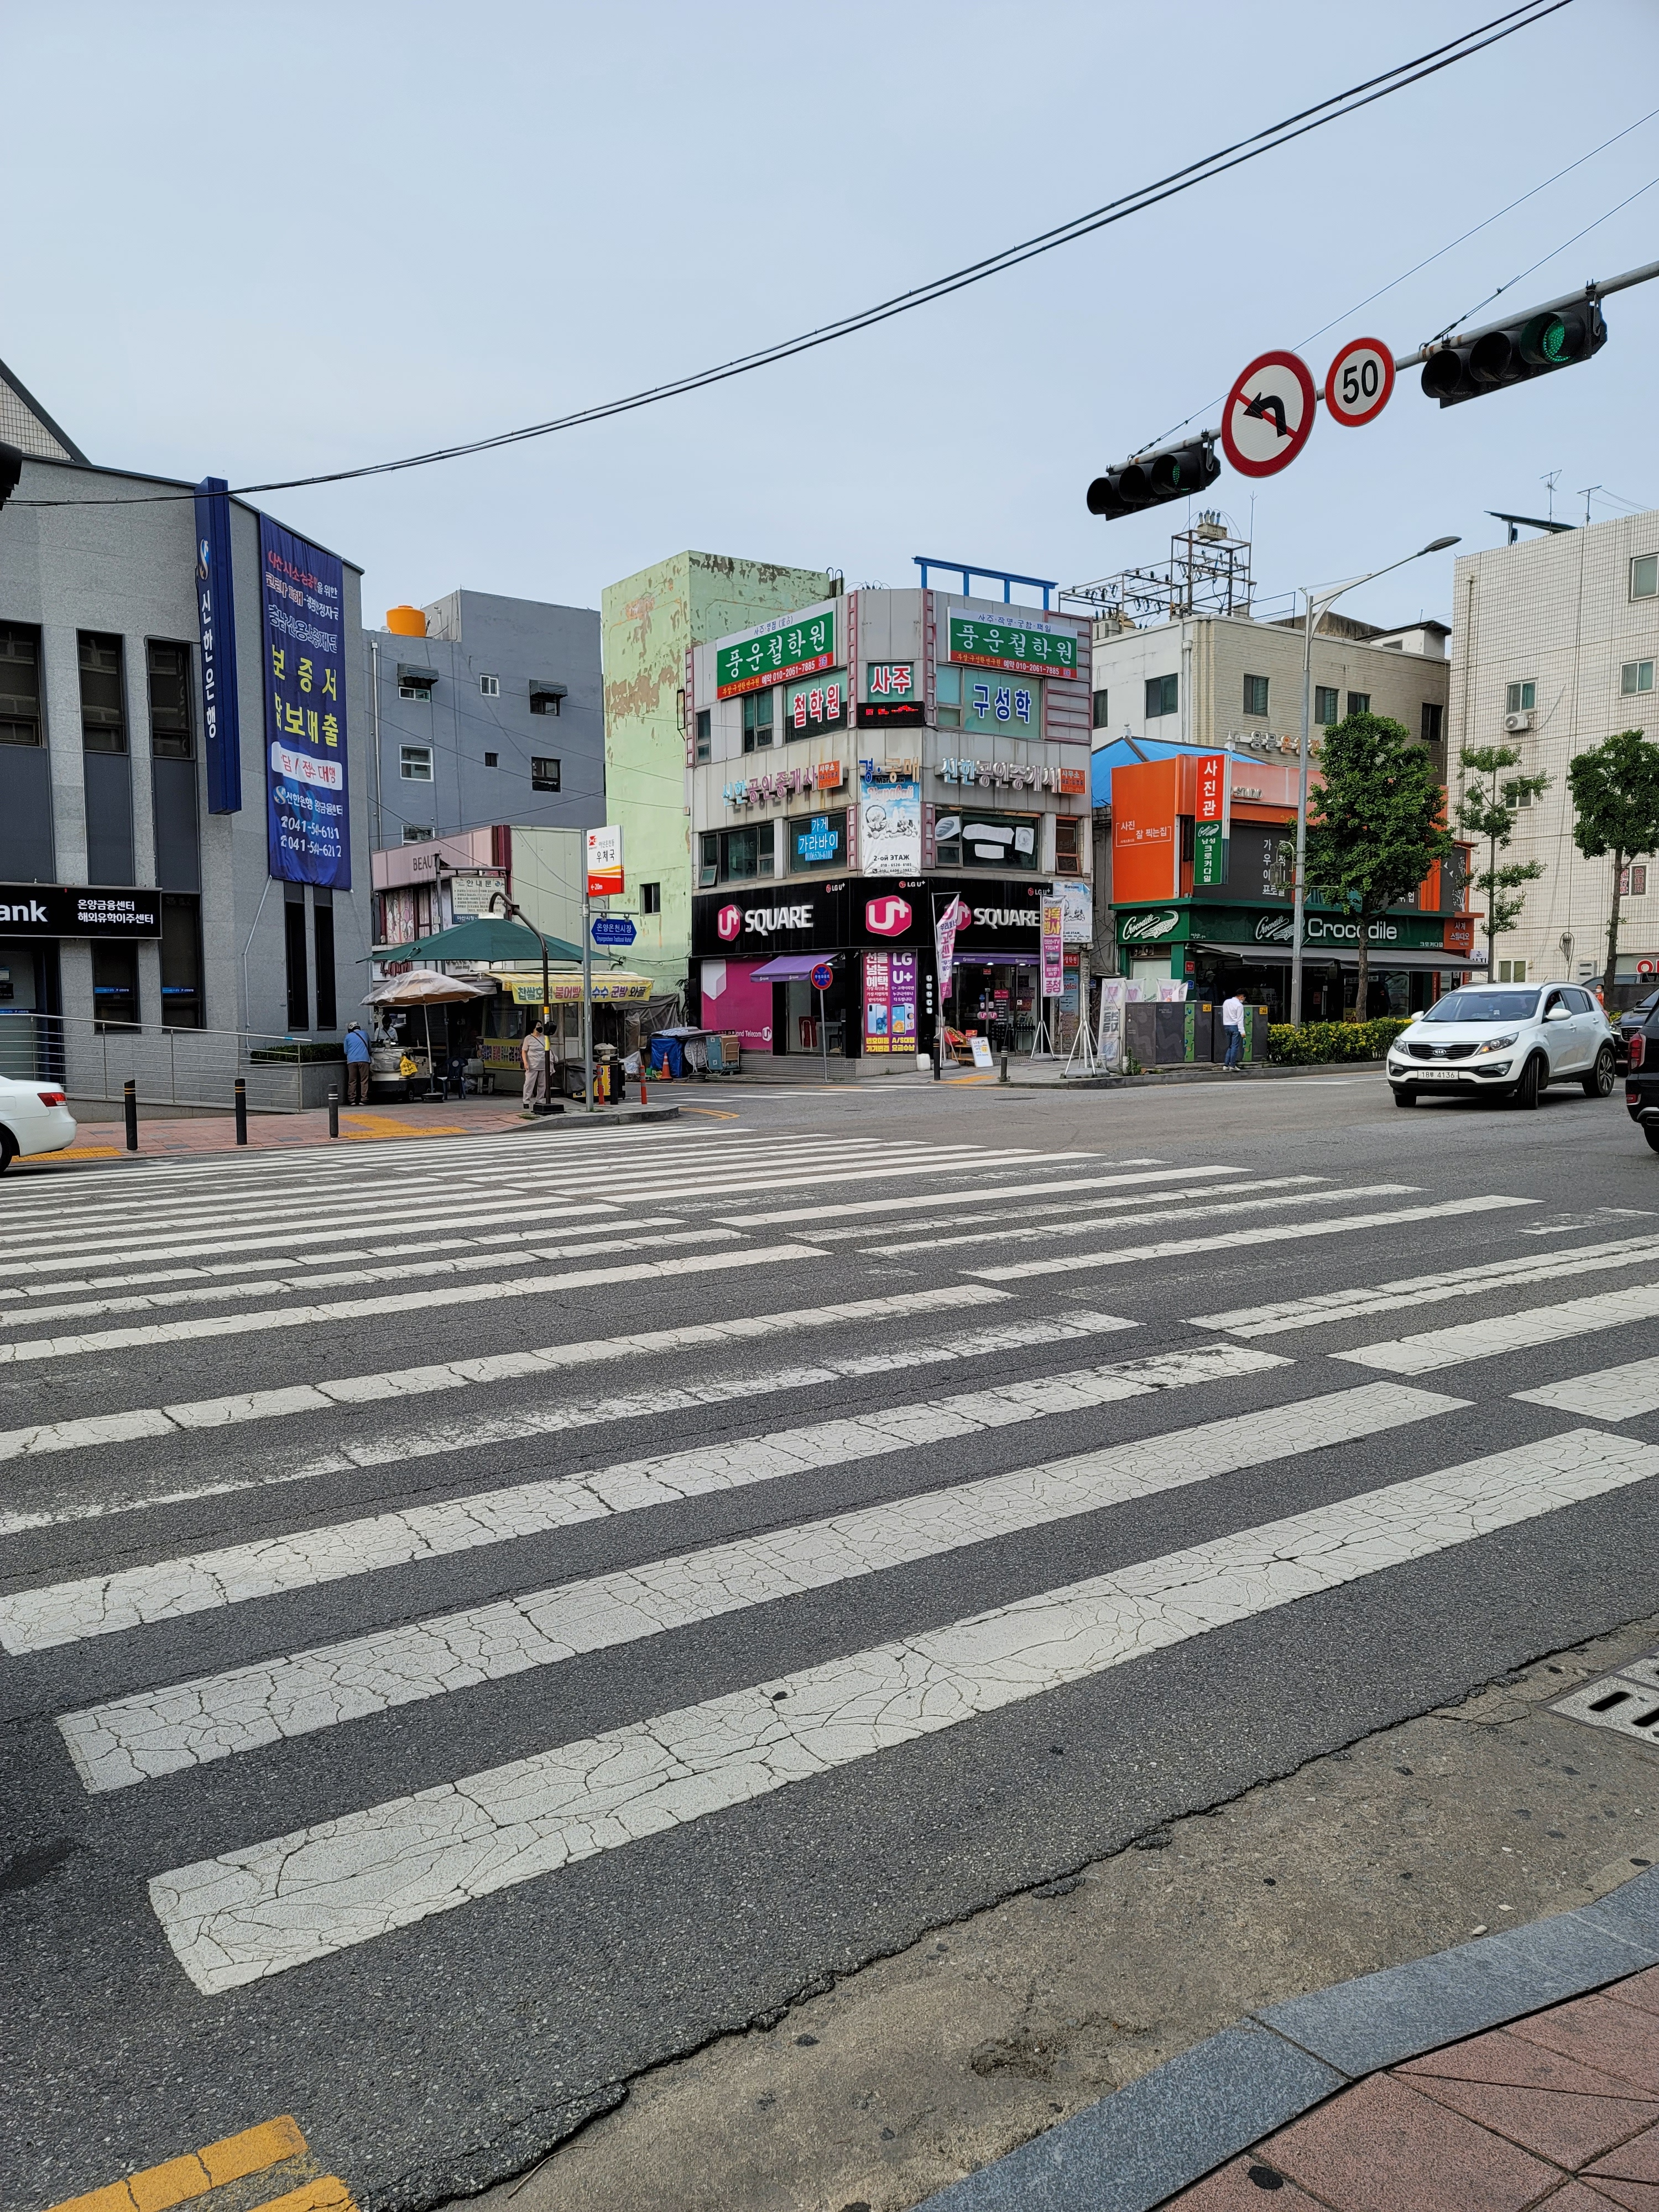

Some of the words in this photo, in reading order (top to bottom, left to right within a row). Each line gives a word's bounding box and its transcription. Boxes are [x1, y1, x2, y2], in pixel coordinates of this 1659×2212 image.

[1343, 359, 1378, 404] 50
[725, 620, 825, 678] 풍운철학원
[956, 624, 1072, 664] 풍운철학원
[202, 589, 216, 738] 신한은행
[1004, 660, 1014, 670] 예약
[1016, 661, 1060, 675] 010-2061-7885
[762, 675, 772, 685] 예약
[773, 660, 815, 681] 010-2061-7885
[871, 666, 911, 694] 사주
[794, 683, 839, 728] 철학원
[973, 684, 1031, 724] 구성학
[820, 763, 835, 773] 사무소
[1062, 770, 1080, 779] 사무소
[1202, 760, 1218, 816] 사진관
[286, 791, 313, 810] 신한은행
[1121, 820, 1135, 831] 사진
[1136, 830, 1143, 839] 잘
[1145, 826, 1167, 838] 찍는집
[799, 831, 838, 852] 가라바이
[596, 849, 614, 863] 우체국
[1203, 846, 1212, 883] 크로커다일
[77, 899, 134, 911] 온양금융센터
[77, 912, 154, 924] 해외유학이주센터
[745, 905, 813, 936] SQUARE
[974, 908, 1040, 929] SQUARE
[1044, 907, 1061, 921] 단독
[597, 923, 632, 933] 온양온천시장
[1044, 921, 1061, 935] 행사
[1123, 914, 1160, 940] Crocodile
[1255, 915, 1289, 940] Crocodile
[1450, 932, 1470, 941] 스튜디오
[866, 952, 888, 963] 선을
[893, 952, 912, 966] LG
[867, 964, 888, 975] 넘는
[893, 971, 913, 984] U+
[866, 976, 888, 987] 혜택
[1046, 980, 1061, 994] 증정
[555, 986, 581, 999] 붕어빵
[583, 986, 609, 999] 수수
[611, 986, 628, 999] 군밤
[629, 986, 647, 998] 와플
